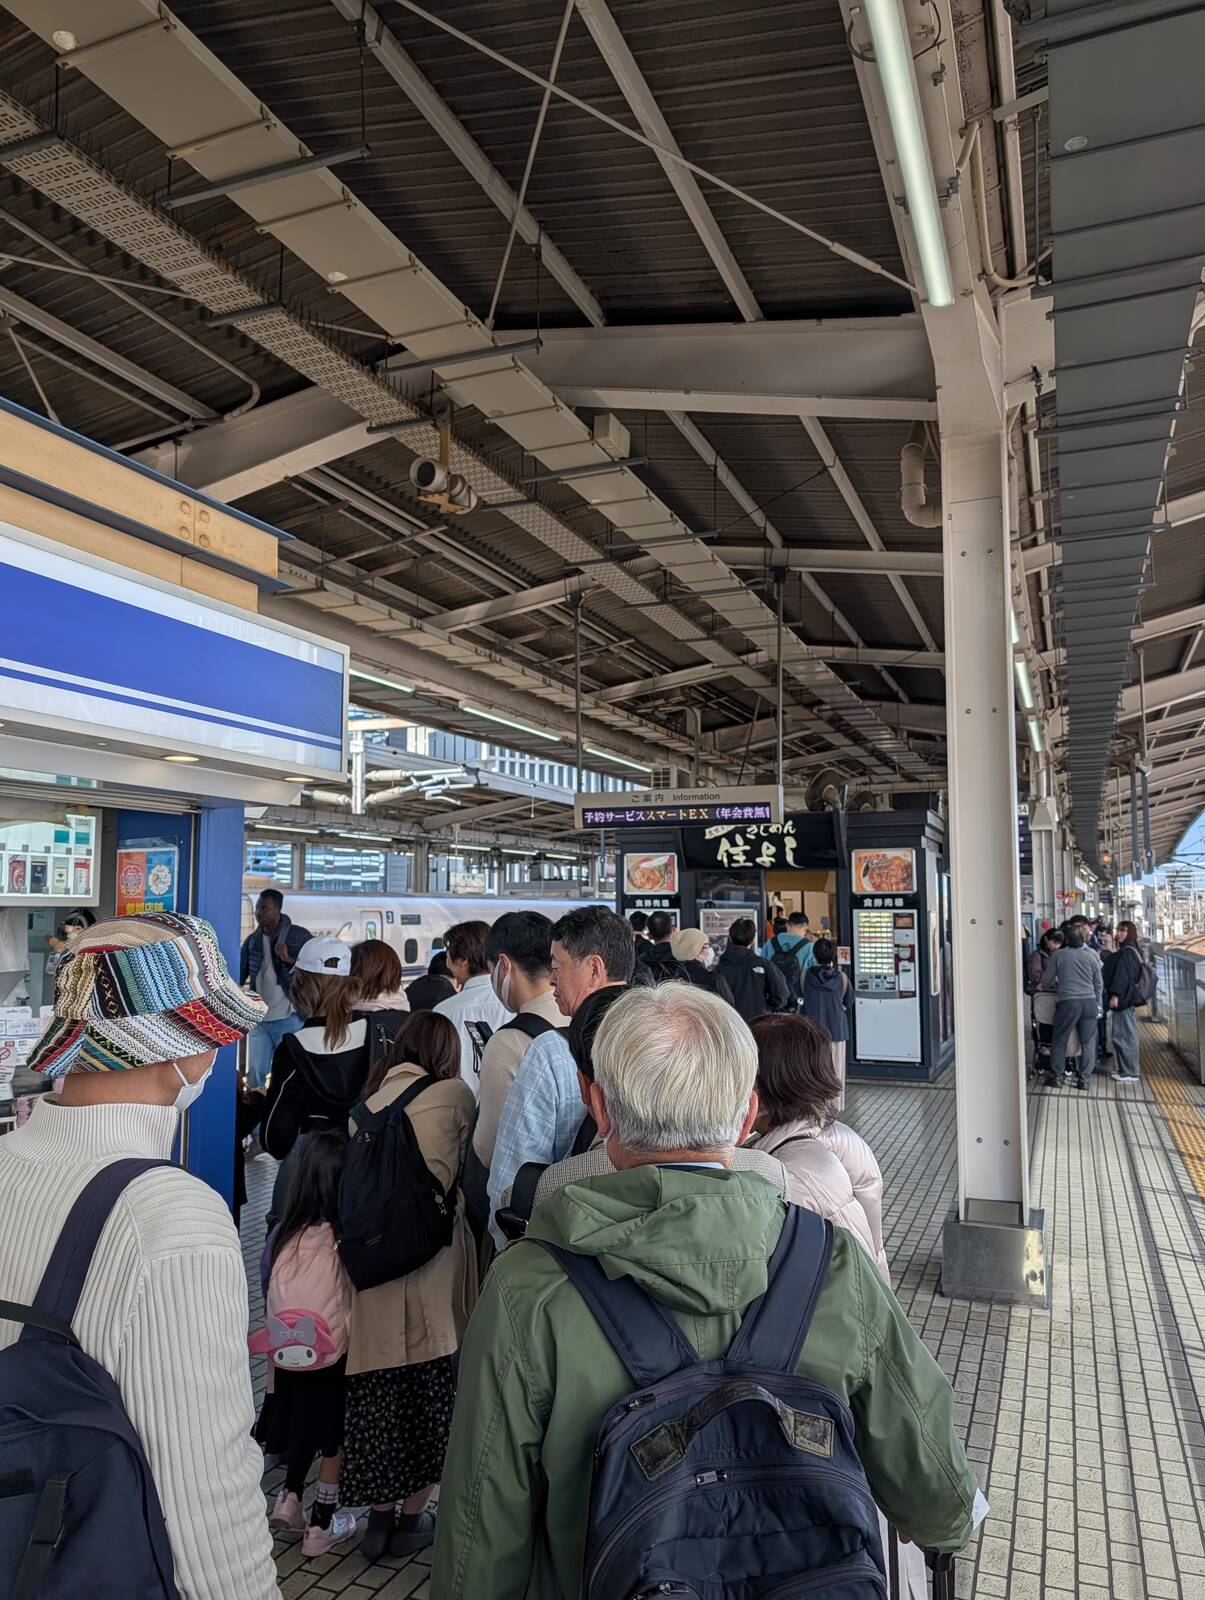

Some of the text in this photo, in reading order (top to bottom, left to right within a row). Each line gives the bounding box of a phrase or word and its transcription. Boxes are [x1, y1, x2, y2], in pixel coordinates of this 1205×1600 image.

[632, 792, 721, 803] ご案内 Information
[716, 833, 804, 868] 住よし
[387, 912, 393, 923] 3
